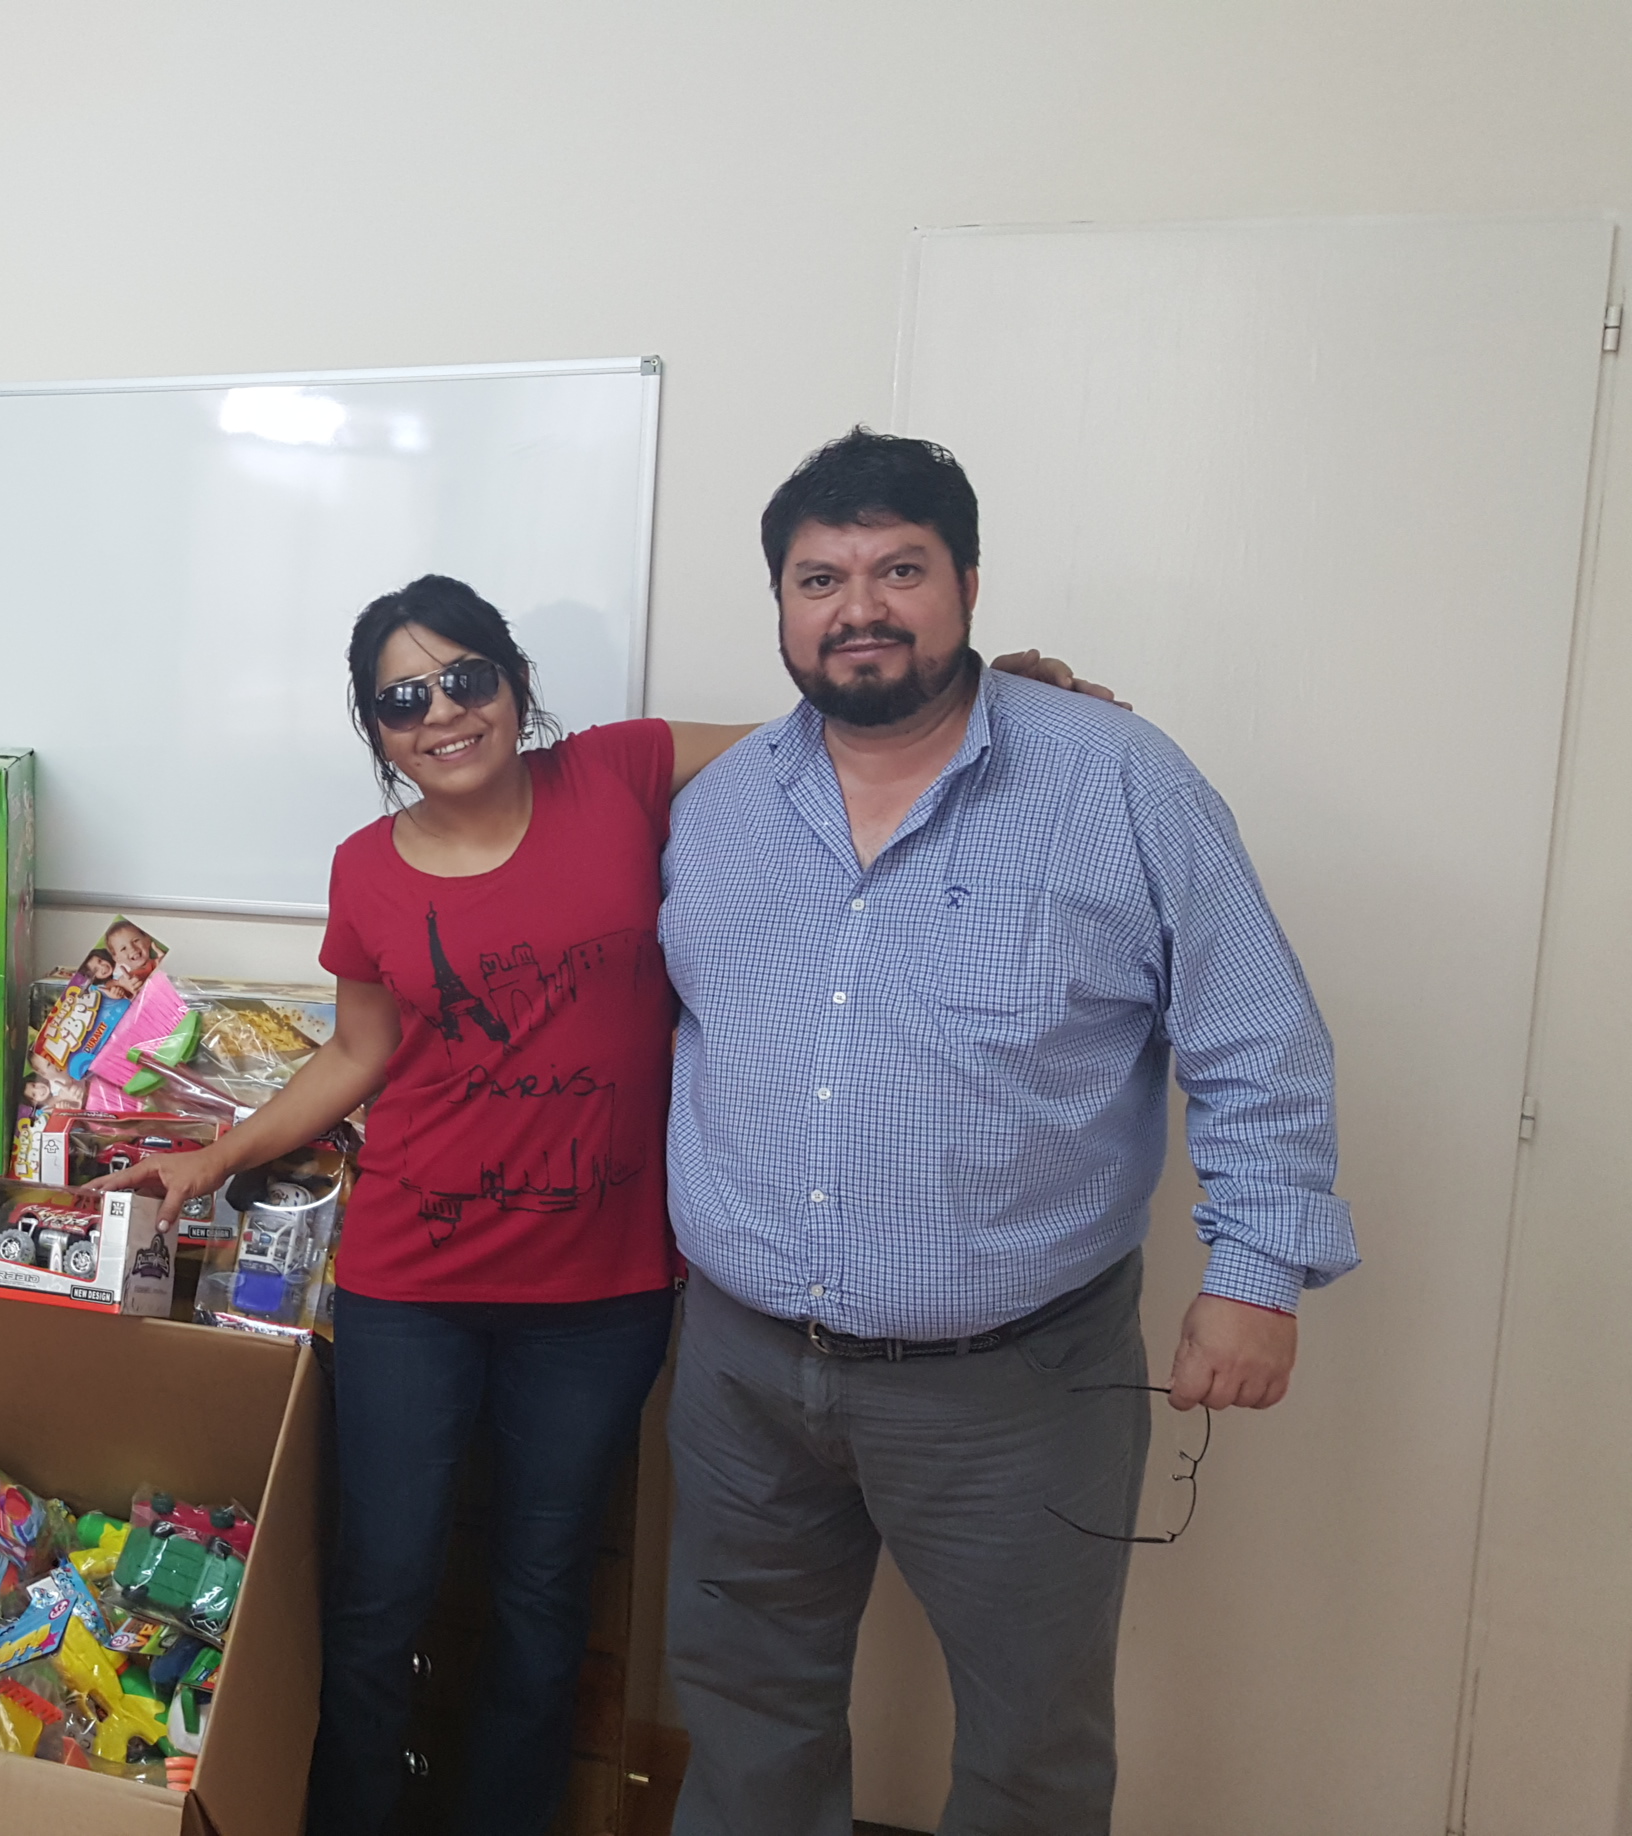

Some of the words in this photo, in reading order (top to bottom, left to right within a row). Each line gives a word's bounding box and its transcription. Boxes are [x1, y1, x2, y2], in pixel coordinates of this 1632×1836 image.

[84, 1022, 108, 1053] DURAVIT
[192, 1228, 206, 1237] NEW
[74, 1288, 87, 1298] NEW
[88, 1290, 111, 1301] DESIGN
